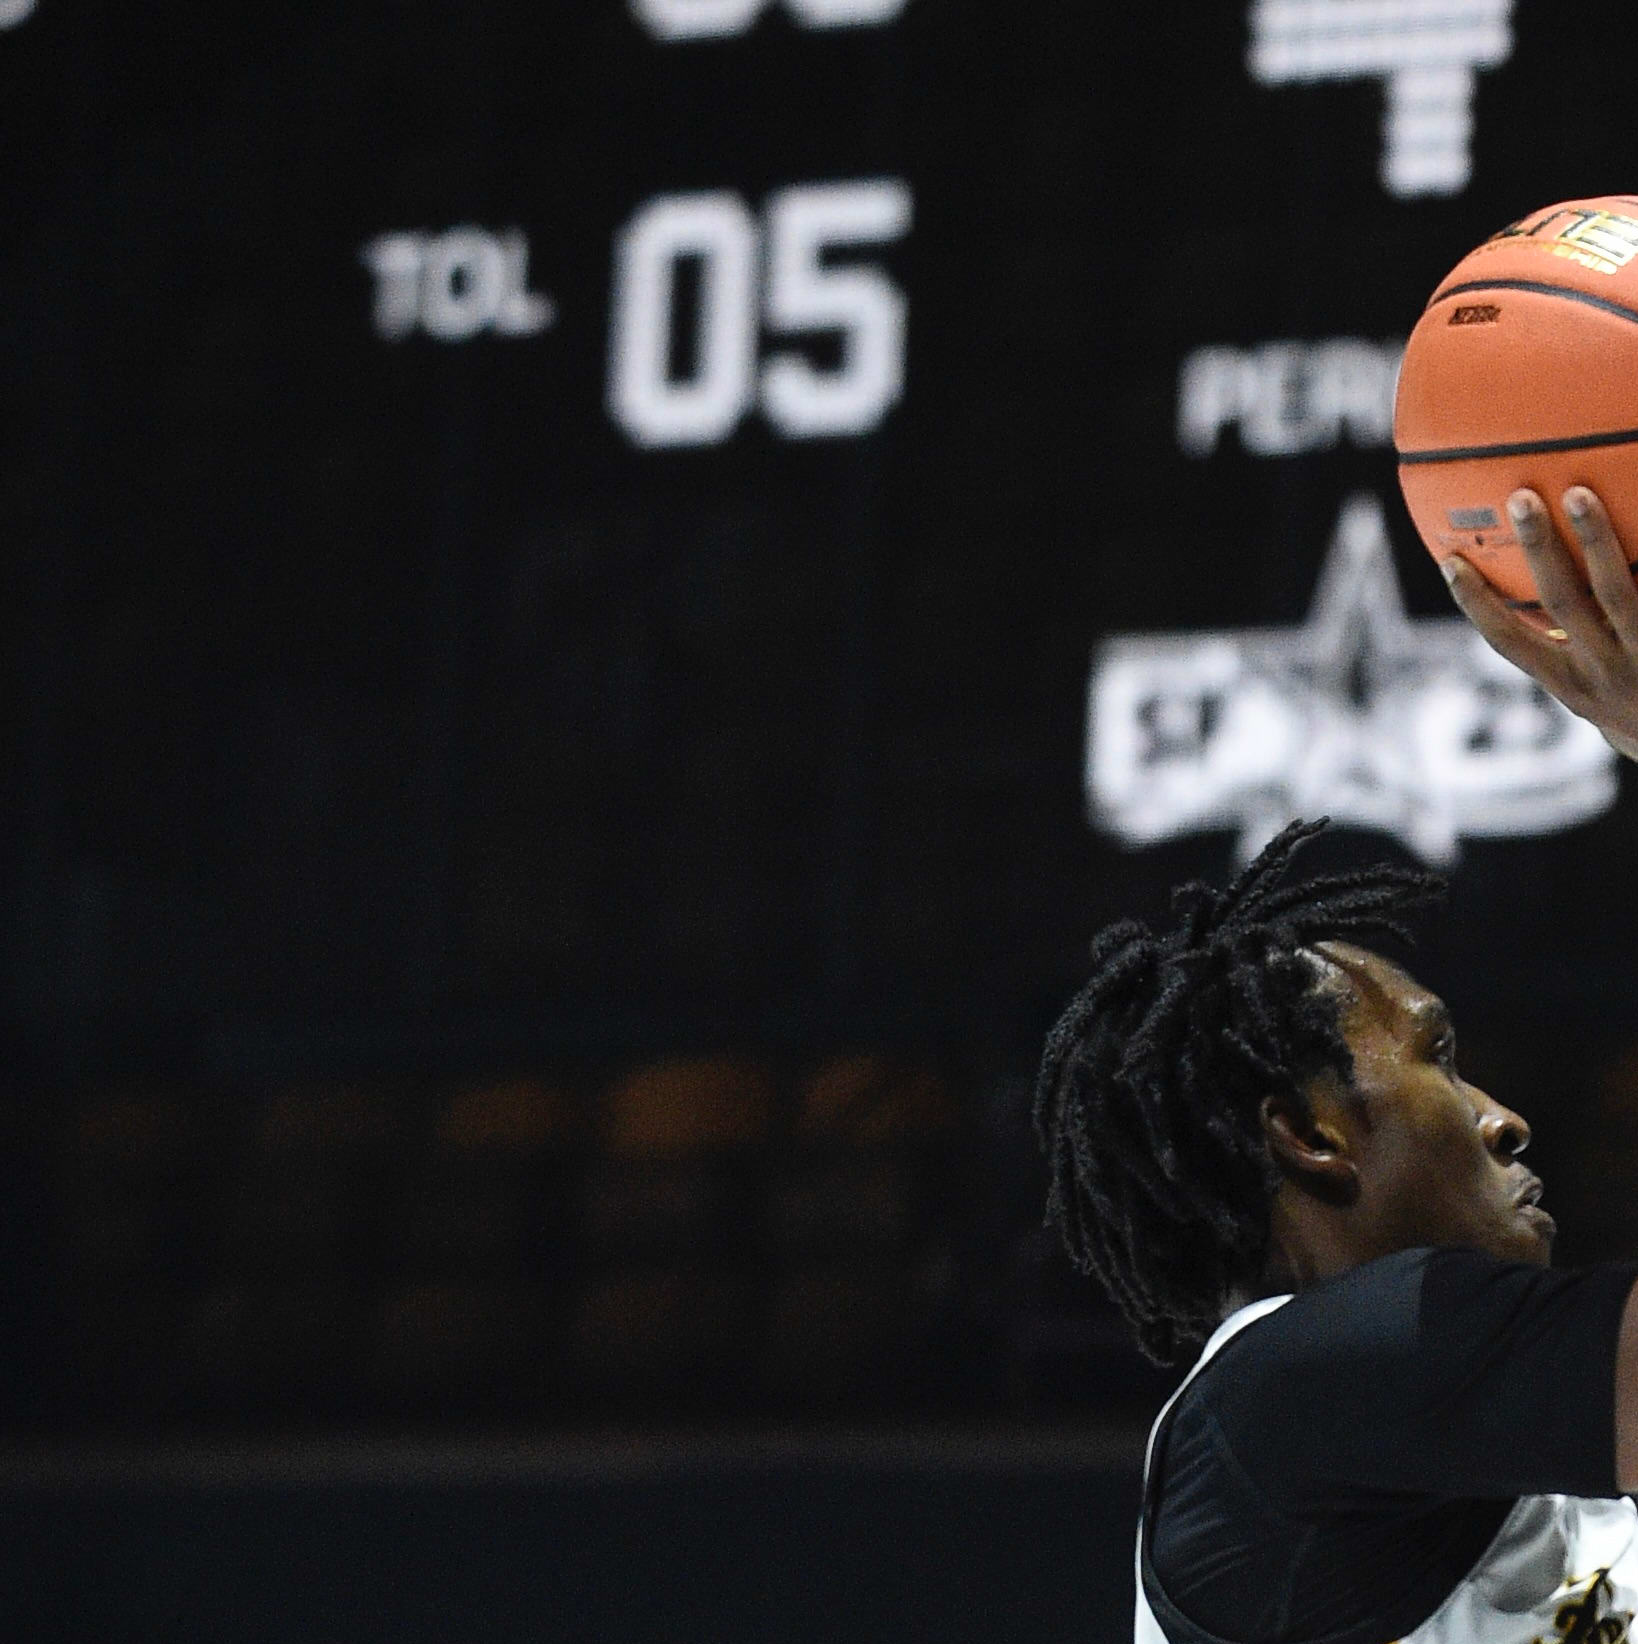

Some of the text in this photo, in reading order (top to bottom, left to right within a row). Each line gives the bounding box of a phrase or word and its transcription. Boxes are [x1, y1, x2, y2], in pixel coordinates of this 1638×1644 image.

[367, 179, 912, 449] TOL 05
[1179, 339, 1405, 456] PER
